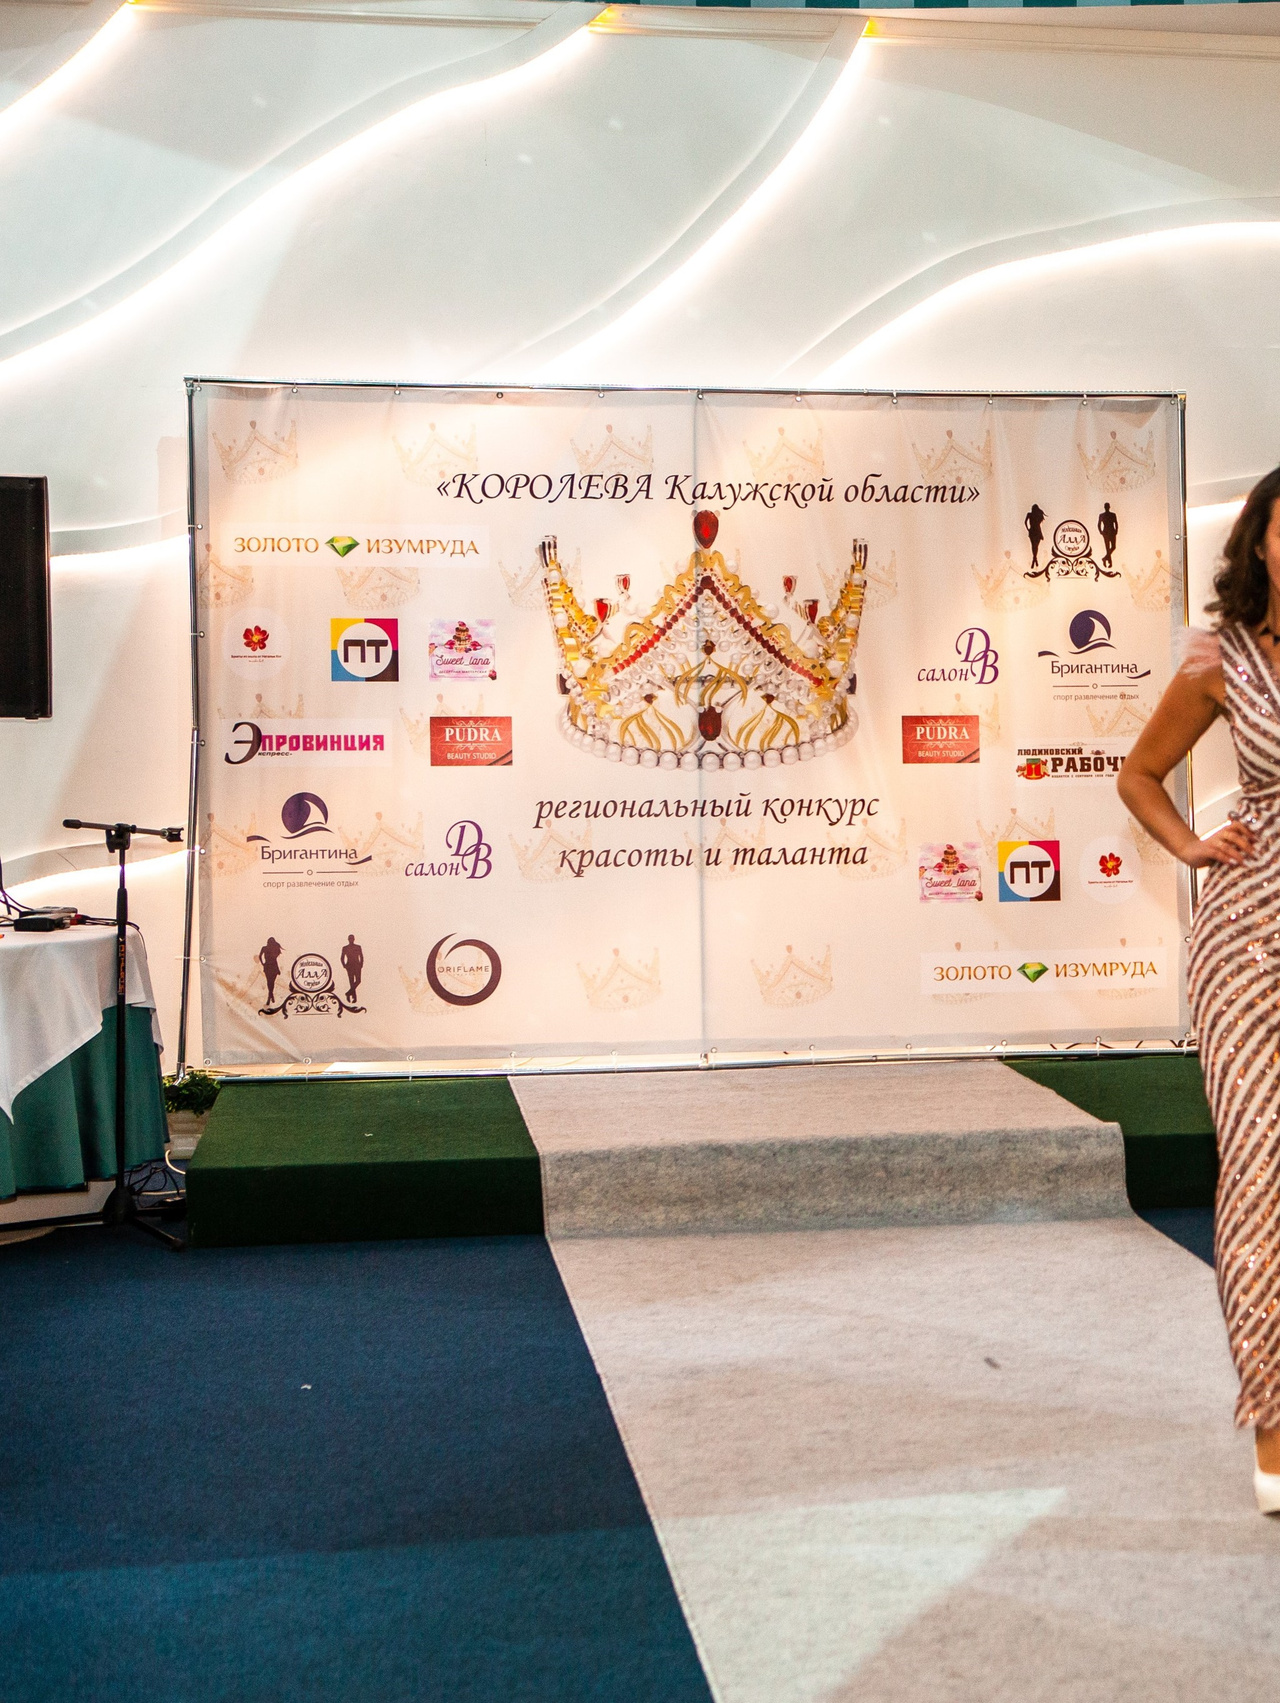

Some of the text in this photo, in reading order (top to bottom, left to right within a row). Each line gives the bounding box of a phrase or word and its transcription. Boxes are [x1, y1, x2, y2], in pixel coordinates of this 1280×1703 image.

[436, 473, 980, 510] «КОРОЛЕВА Калужской области»
[234, 537, 479, 557] ЗОЛОТО ИЗУМРУДА
[343, 639, 389, 663] ПТ
[917, 667, 969, 682] салон
[1051, 660, 1139, 678] Бригантина
[1074, 693, 1118, 701] развлечение
[1119, 692, 1140, 701] отдых
[444, 727, 502, 742] PUDRA
[915, 726, 970, 740] PUDRA
[446, 752, 497, 760] BEAUTY STUDIO
[917, 750, 965, 758] BEAUTY STUDIO
[1017, 747, 1083, 756] ЛЮДИНОВСКИЙ
[533, 792, 880, 829] региональный конкурс
[261, 845, 358, 864] Бригантина
[559, 846, 869, 877] красоты и таланта
[405, 862, 461, 877] салон
[1010, 860, 1051, 884] ПТ
[263, 881, 285, 889] спорт
[286, 880, 336, 888] развлечение
[437, 965, 490, 973] ORIFLAME
[933, 961, 1158, 982] ЗОЛОТО ИЗУМРУДА
